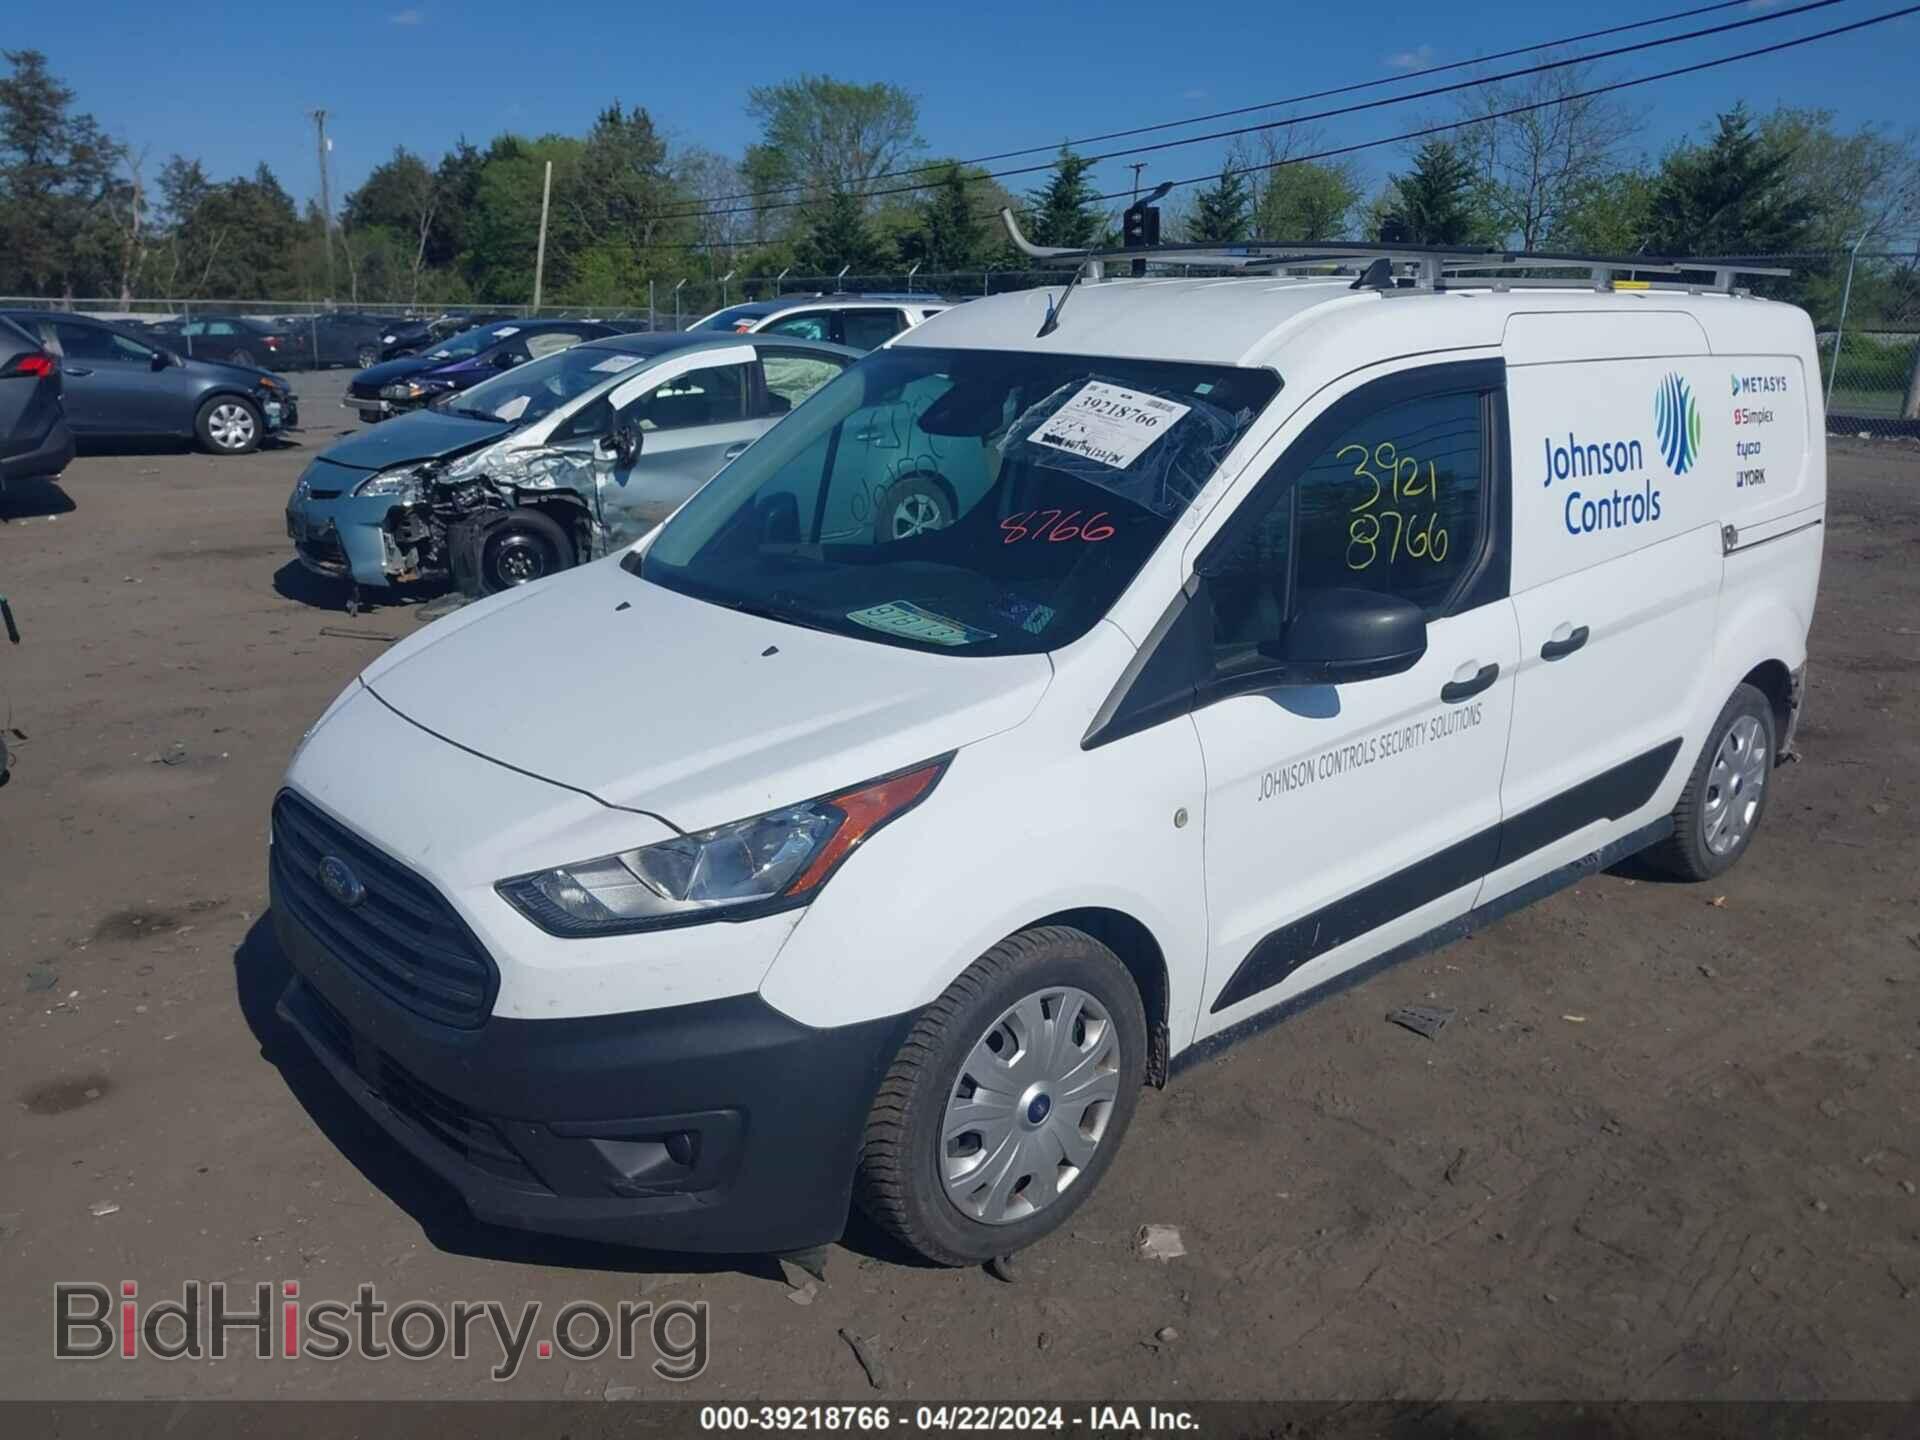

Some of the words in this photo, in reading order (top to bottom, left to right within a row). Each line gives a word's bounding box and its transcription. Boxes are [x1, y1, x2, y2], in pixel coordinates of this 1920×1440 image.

[1742, 376, 1787, 393] METASYS
[1076, 396, 1159, 428] 39218766
[1742, 407, 1774, 426] Simplex
[1544, 432, 1643, 488] Johnson
[1736, 440, 1761, 461] tyco
[1336, 442, 1437, 512] 3921
[1744, 468, 1766, 486] YORK
[1565, 480, 1661, 535] Controls
[1000, 509, 1115, 544] 8766
[1345, 511, 1448, 570] 8766
[1258, 759, 1315, 801] JOHNSON
[1319, 738, 1376, 780] CONTROLS
[1379, 723, 1427, 759] SECURITY
[1430, 702, 1483, 741] SOLUTIONS
